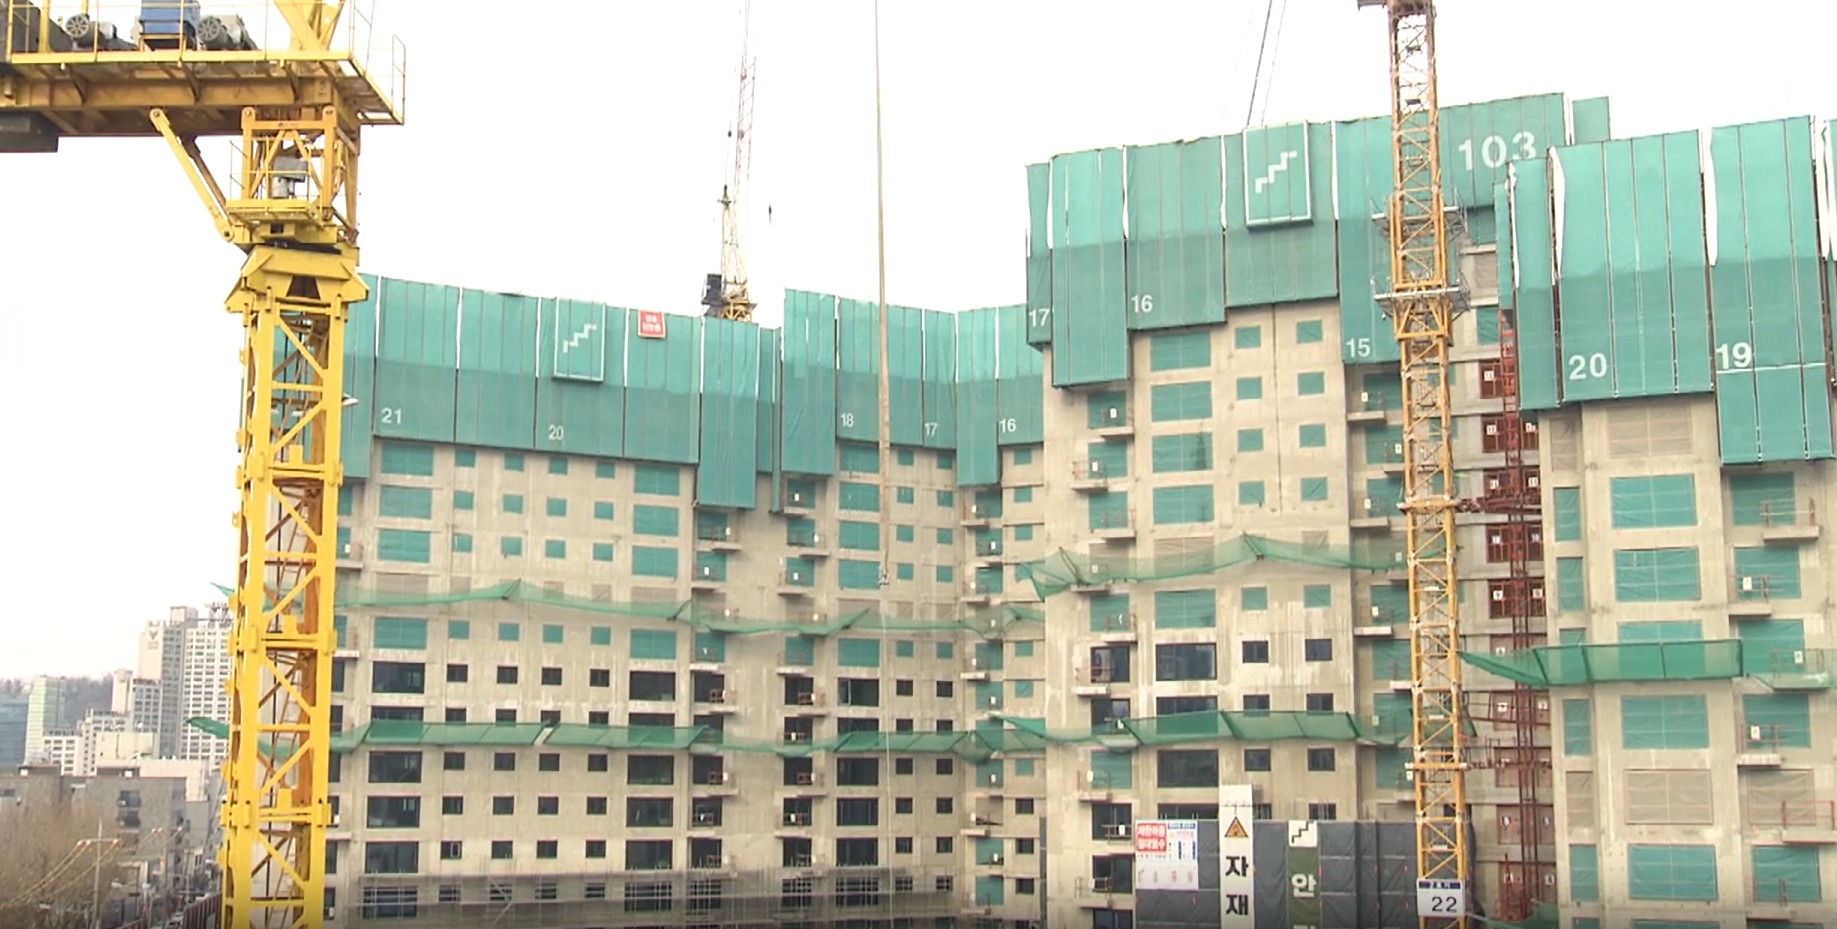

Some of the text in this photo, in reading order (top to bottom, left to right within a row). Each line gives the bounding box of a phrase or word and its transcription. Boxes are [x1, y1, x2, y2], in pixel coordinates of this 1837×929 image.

[1458, 130, 1537, 171] 103
[1131, 294, 1153, 313] 16
[1029, 308, 1051, 327] 17
[1345, 337, 1371, 358] 15
[1715, 342, 1752, 370] 19
[1568, 352, 1607, 380] 20
[381, 407, 402, 424] 21
[840, 412, 854, 428] 18
[548, 424, 564, 440] 20
[924, 422, 938, 437] 17
[999, 418, 1017, 433] 16
[1225, 855, 1249, 916] 자재
[1431, 896, 1457, 913] 22
